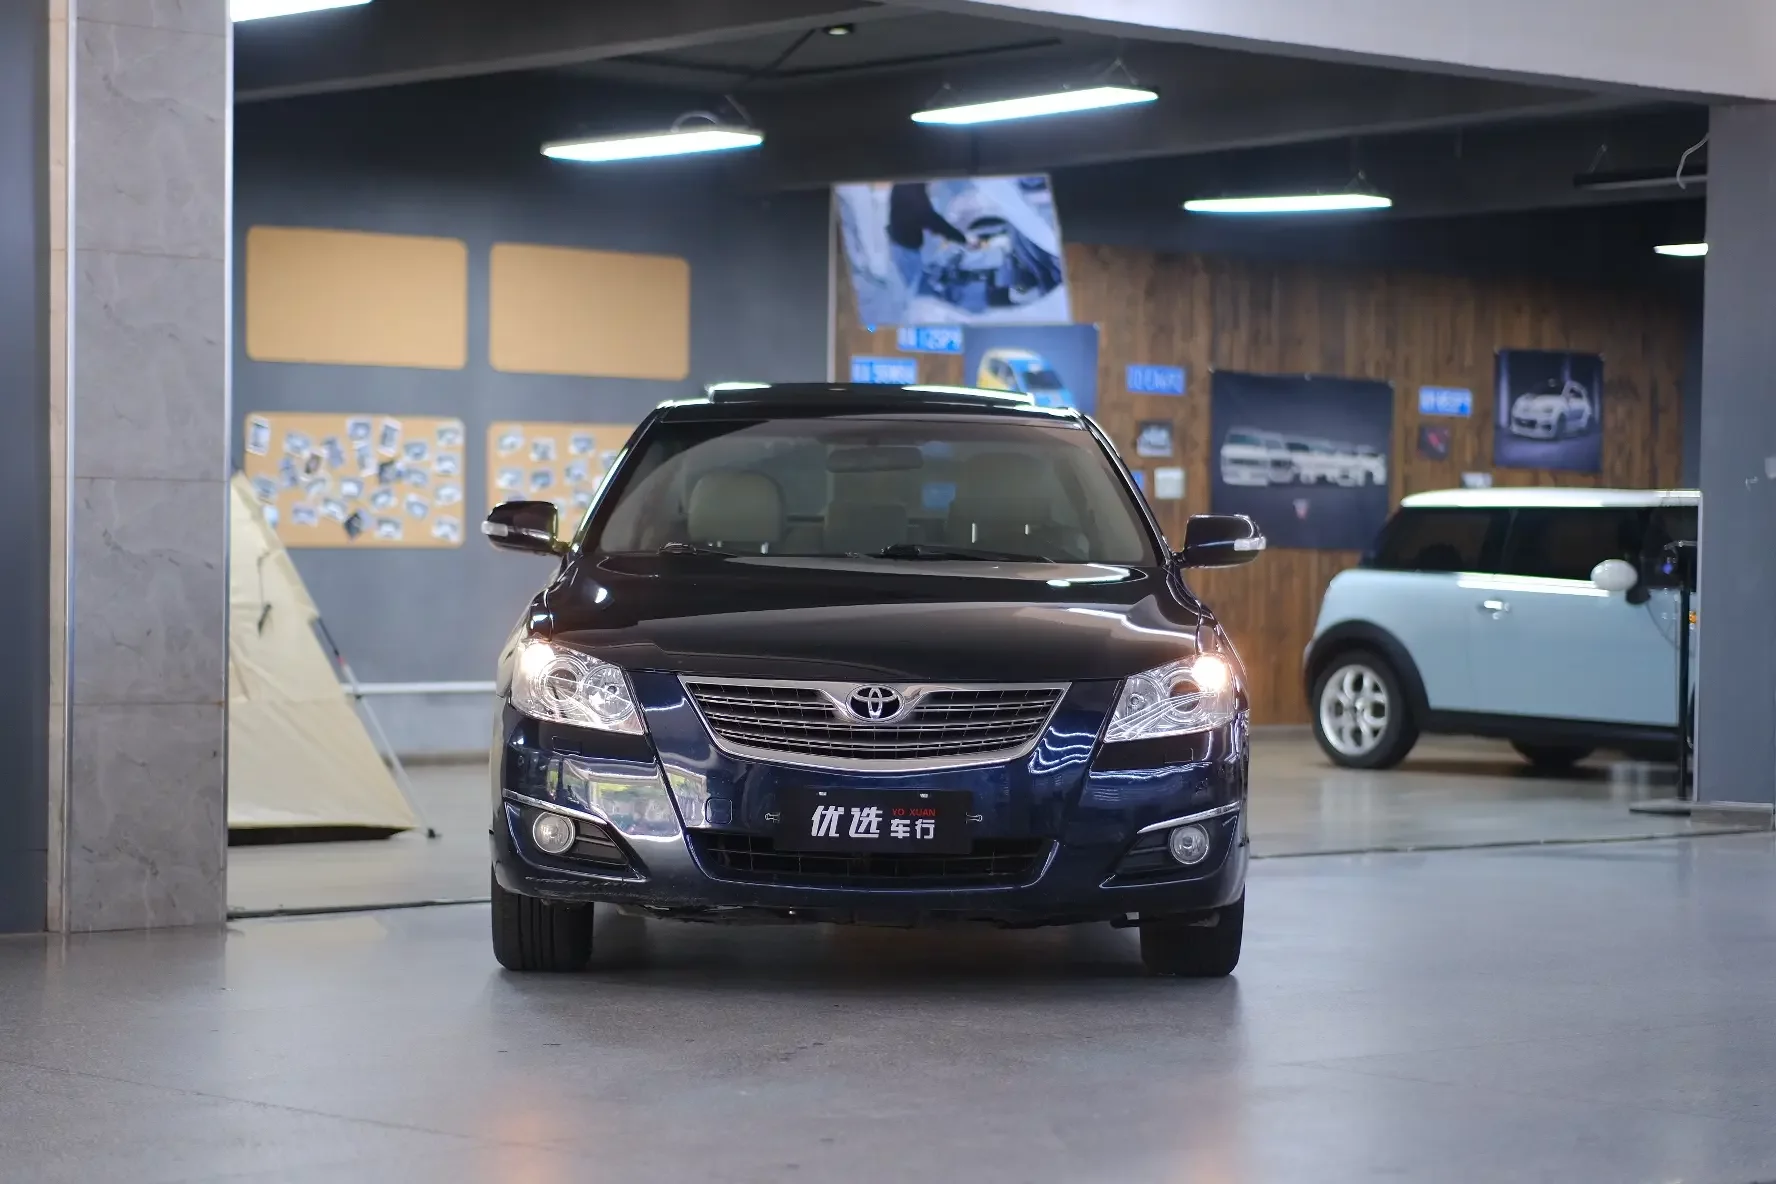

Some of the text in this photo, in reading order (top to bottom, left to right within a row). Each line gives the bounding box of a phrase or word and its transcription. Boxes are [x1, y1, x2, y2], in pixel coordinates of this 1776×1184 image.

[811, 805, 883, 839] 优选
[892, 808, 936, 817] YO XUAN
[890, 818, 935, 839] 车行
